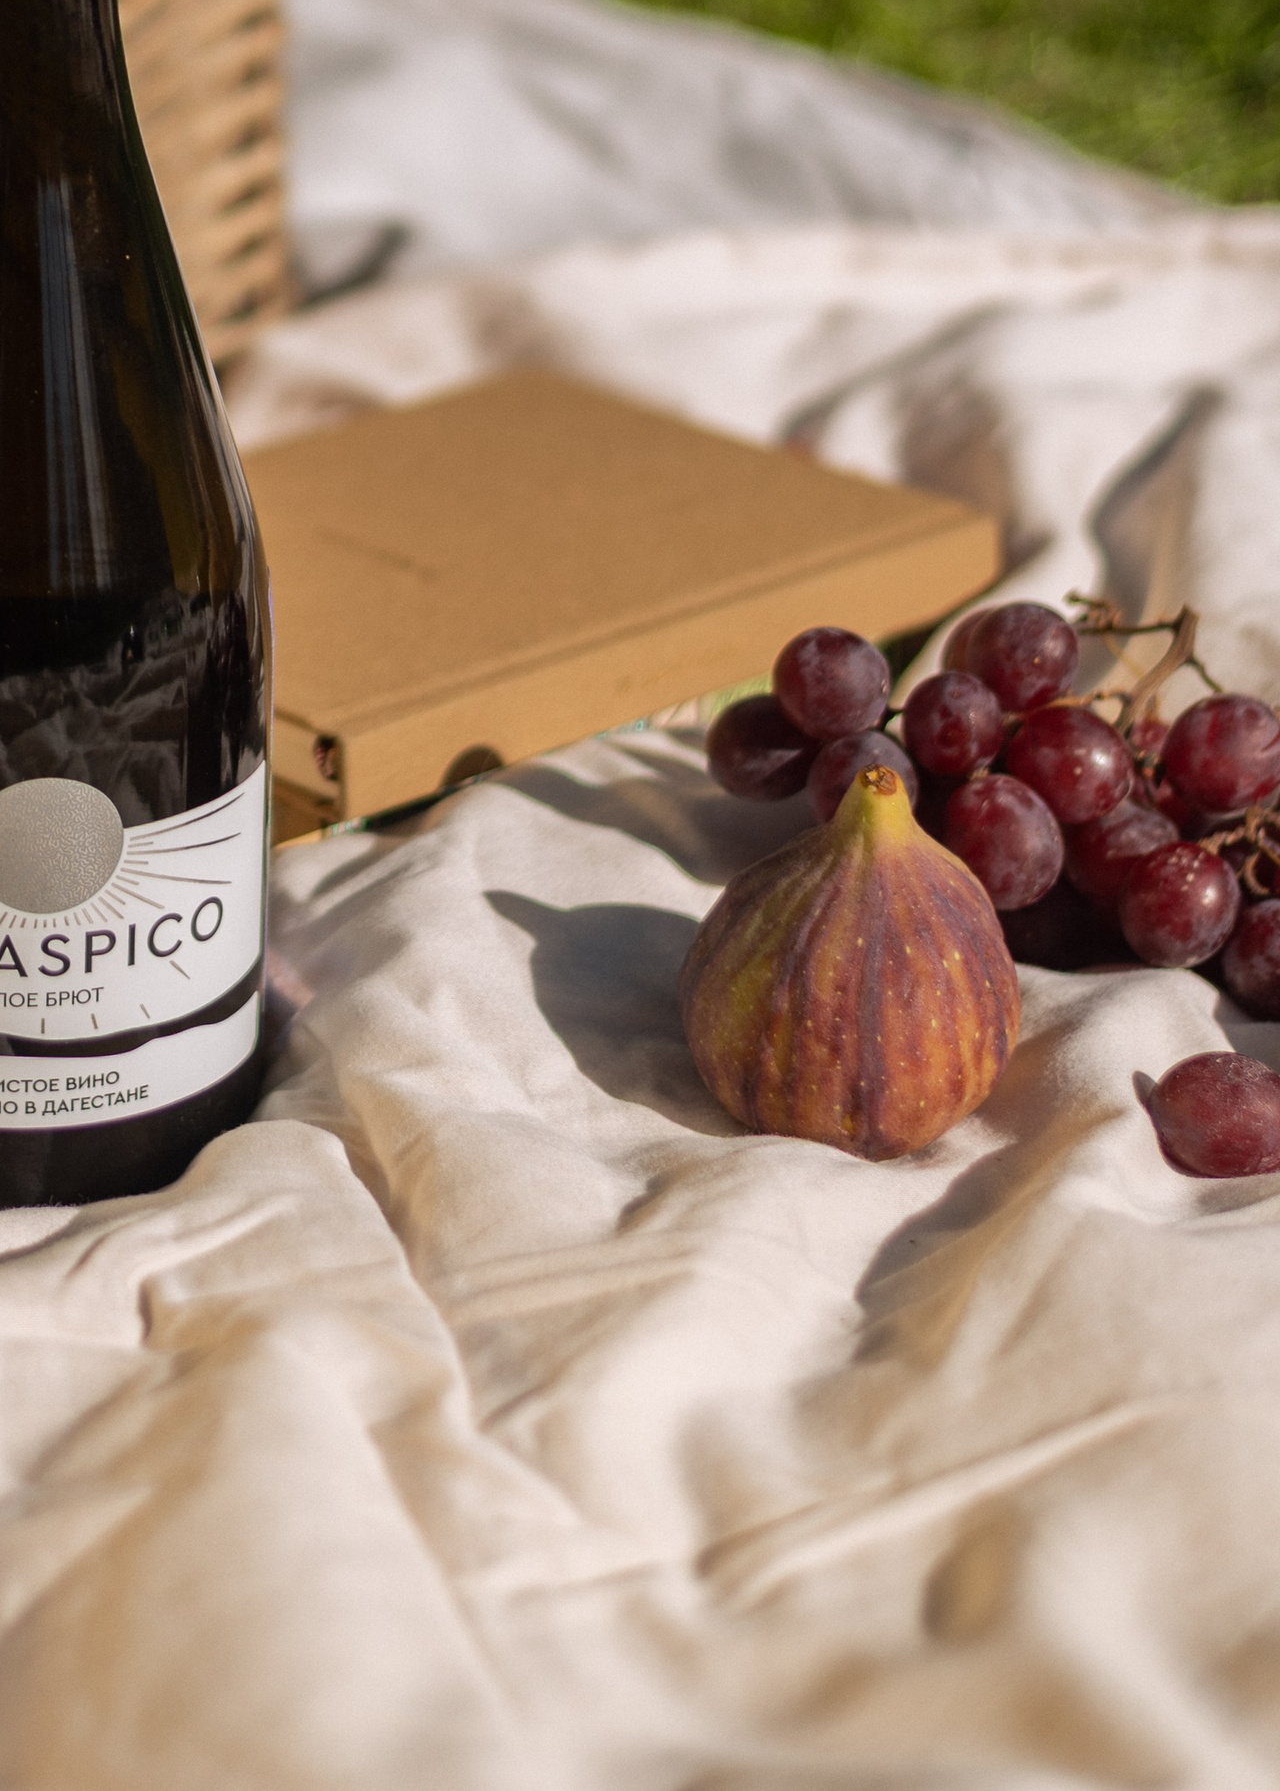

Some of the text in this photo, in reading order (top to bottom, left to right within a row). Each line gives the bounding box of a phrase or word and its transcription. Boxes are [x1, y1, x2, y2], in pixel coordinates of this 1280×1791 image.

[45, 986, 105, 1008] БРЮТ
[66, 1070, 120, 1090] ВИНО
[24, 1100, 37, 1115] В
[41, 1084, 150, 1117] ДАГЕСТАНЕ
